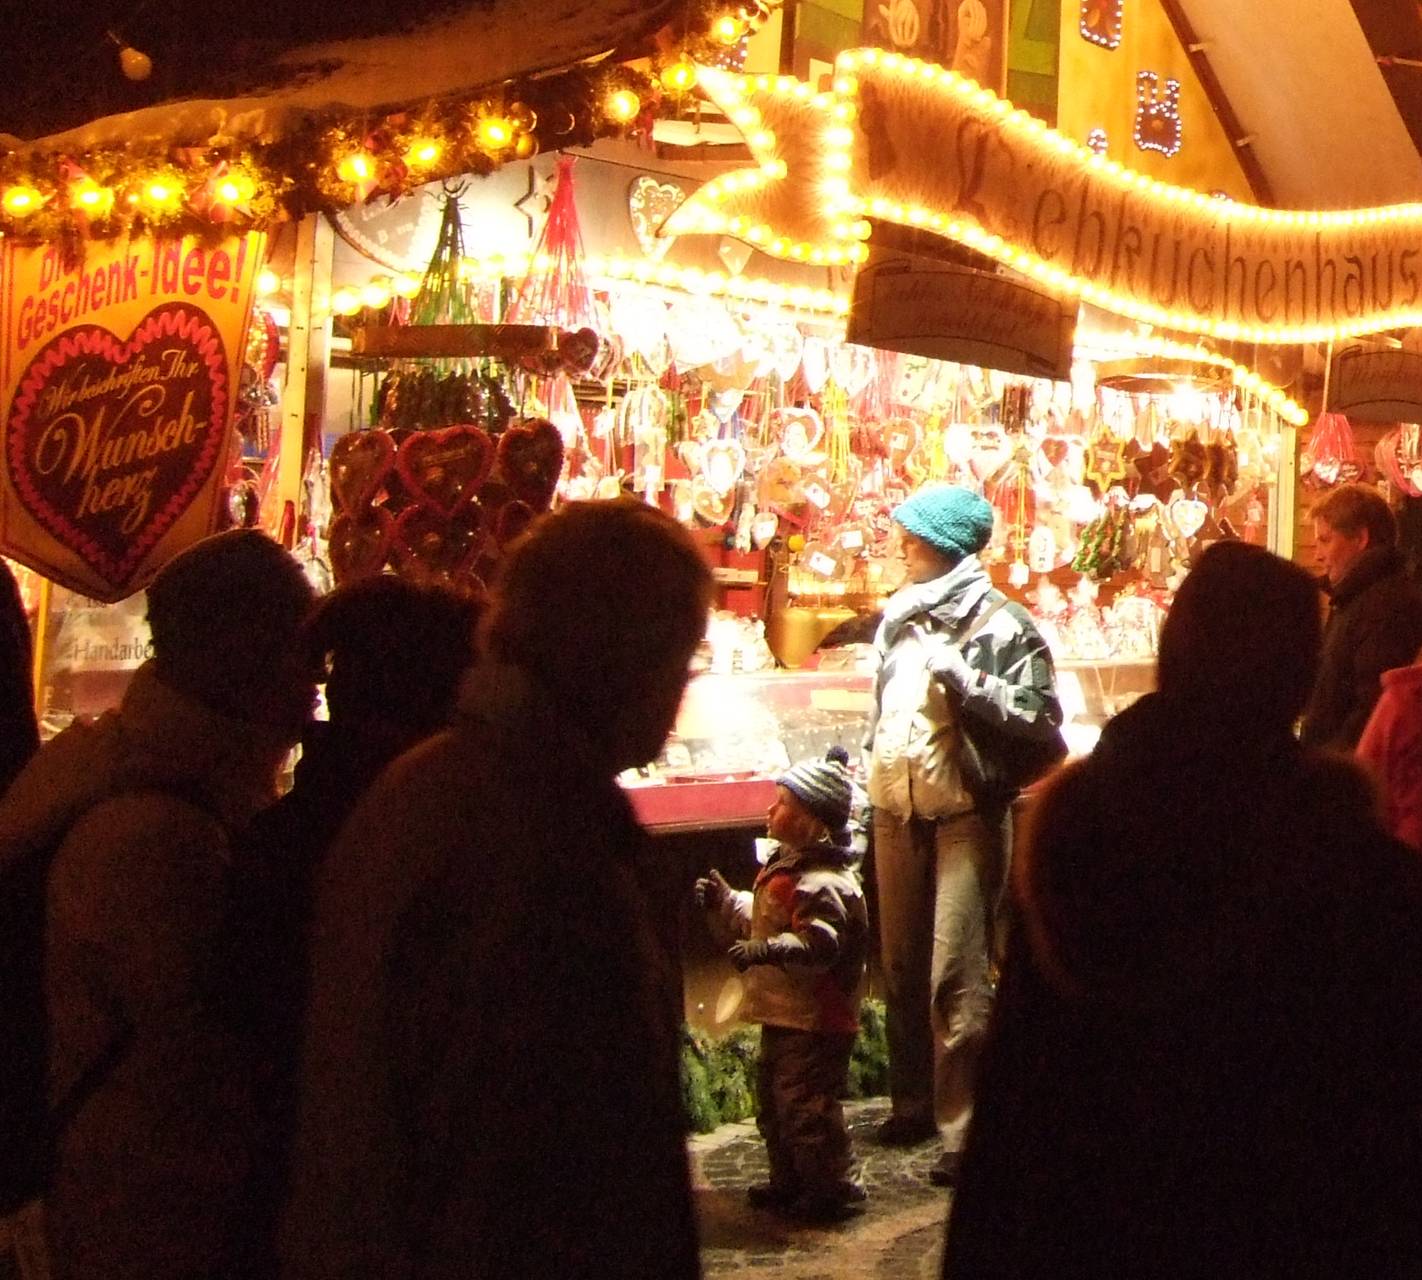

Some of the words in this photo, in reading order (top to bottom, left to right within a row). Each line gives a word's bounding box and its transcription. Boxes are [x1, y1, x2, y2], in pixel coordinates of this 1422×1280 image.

[18, 236, 247, 349] Geschenk-Idee!
[35, 383, 208, 486] Wunsch-
[75, 464, 158, 535] herz
[73, 638, 156, 661] Handarbe
